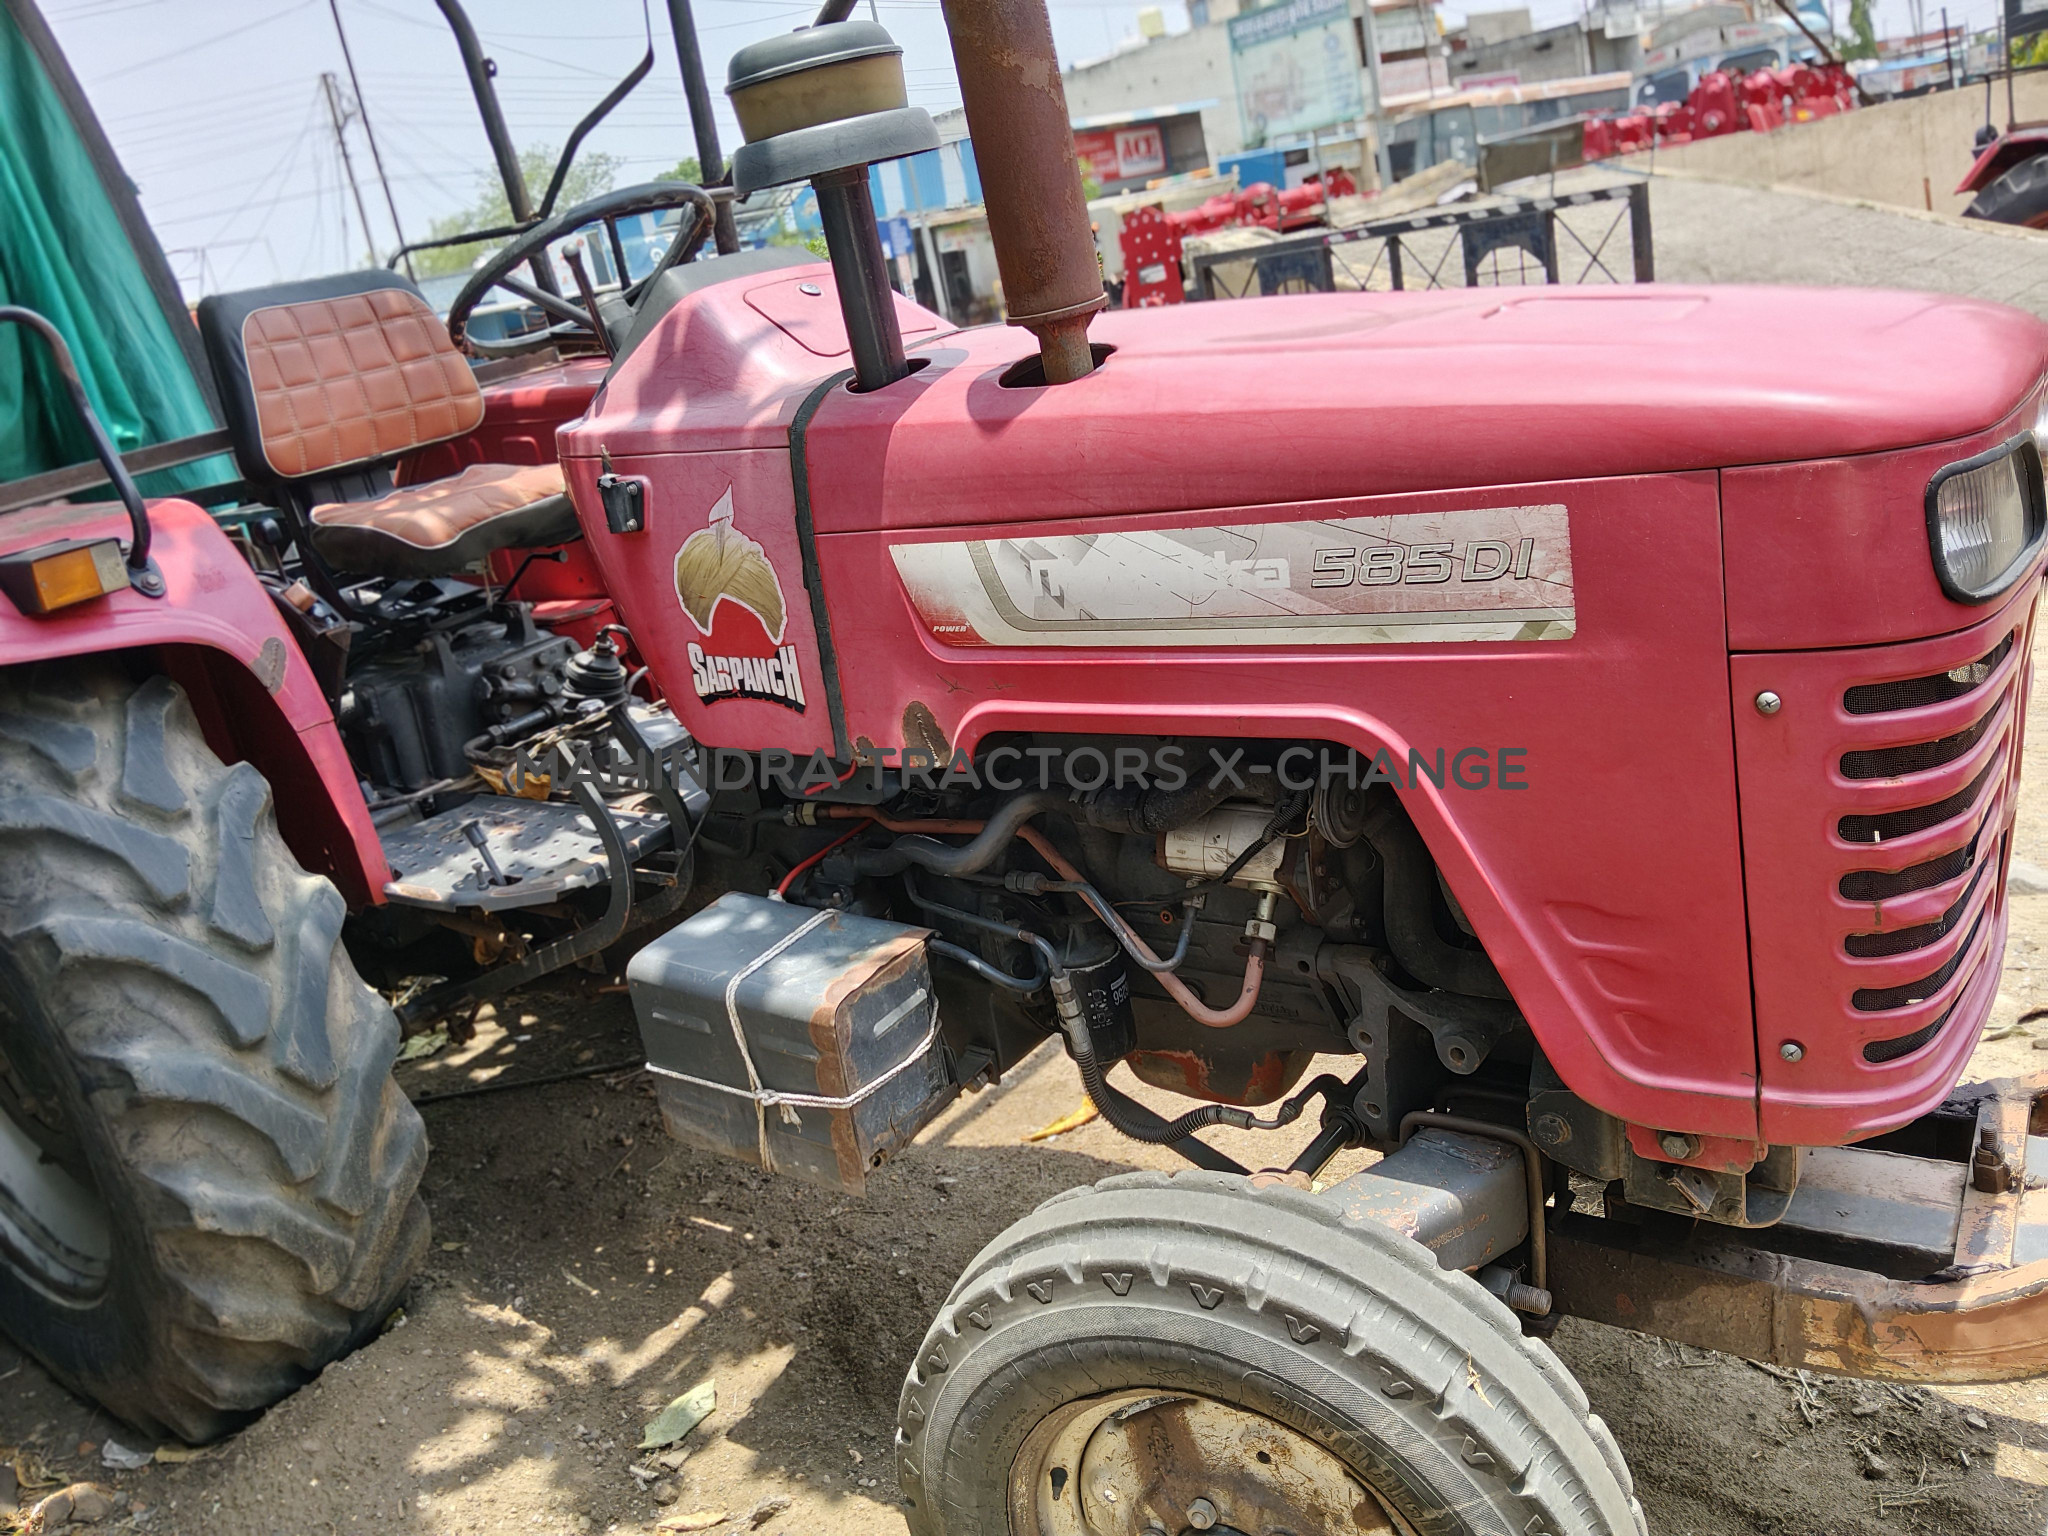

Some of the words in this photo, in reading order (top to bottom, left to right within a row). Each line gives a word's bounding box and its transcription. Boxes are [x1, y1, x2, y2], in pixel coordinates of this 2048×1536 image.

[1311, 543, 1454, 588] 585
[1461, 538, 1535, 582] DI
[687, 642, 807, 712] SARPANCH
